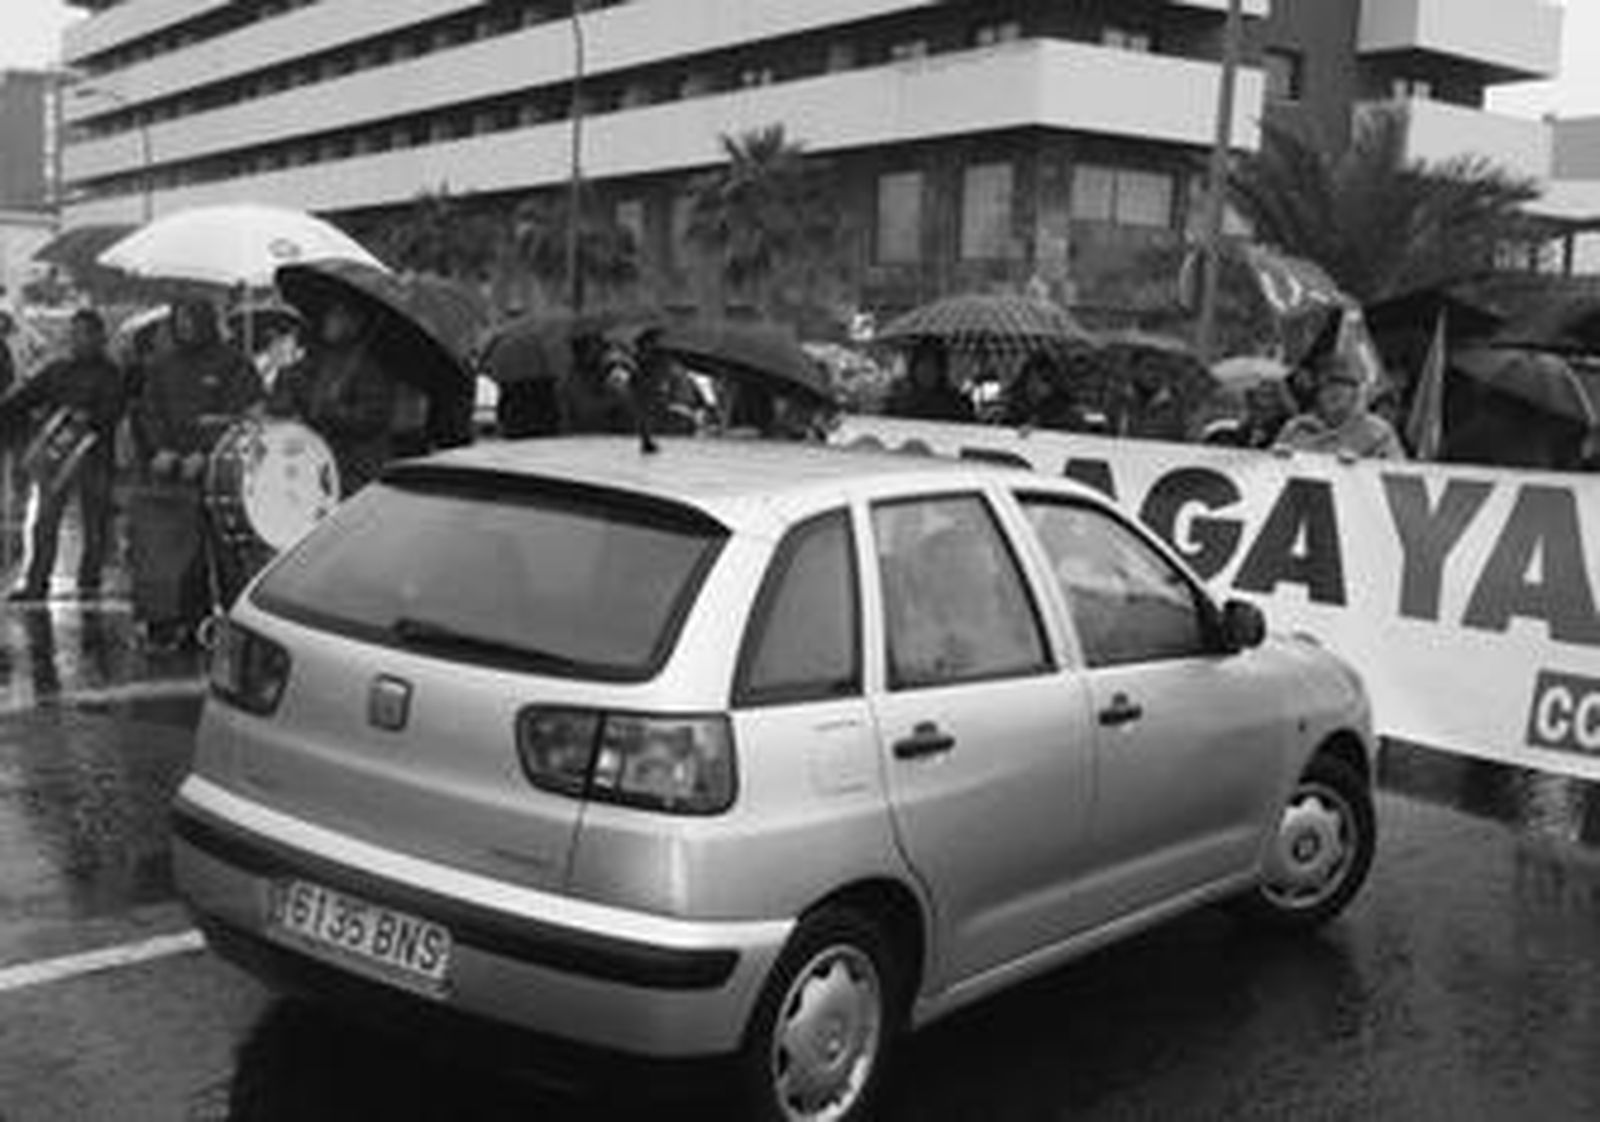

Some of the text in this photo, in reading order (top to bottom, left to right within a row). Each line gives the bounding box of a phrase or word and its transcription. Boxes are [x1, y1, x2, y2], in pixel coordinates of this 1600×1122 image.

[1380, 472, 1600, 647] YA
[291, 885, 443, 971] 6135 BNS
